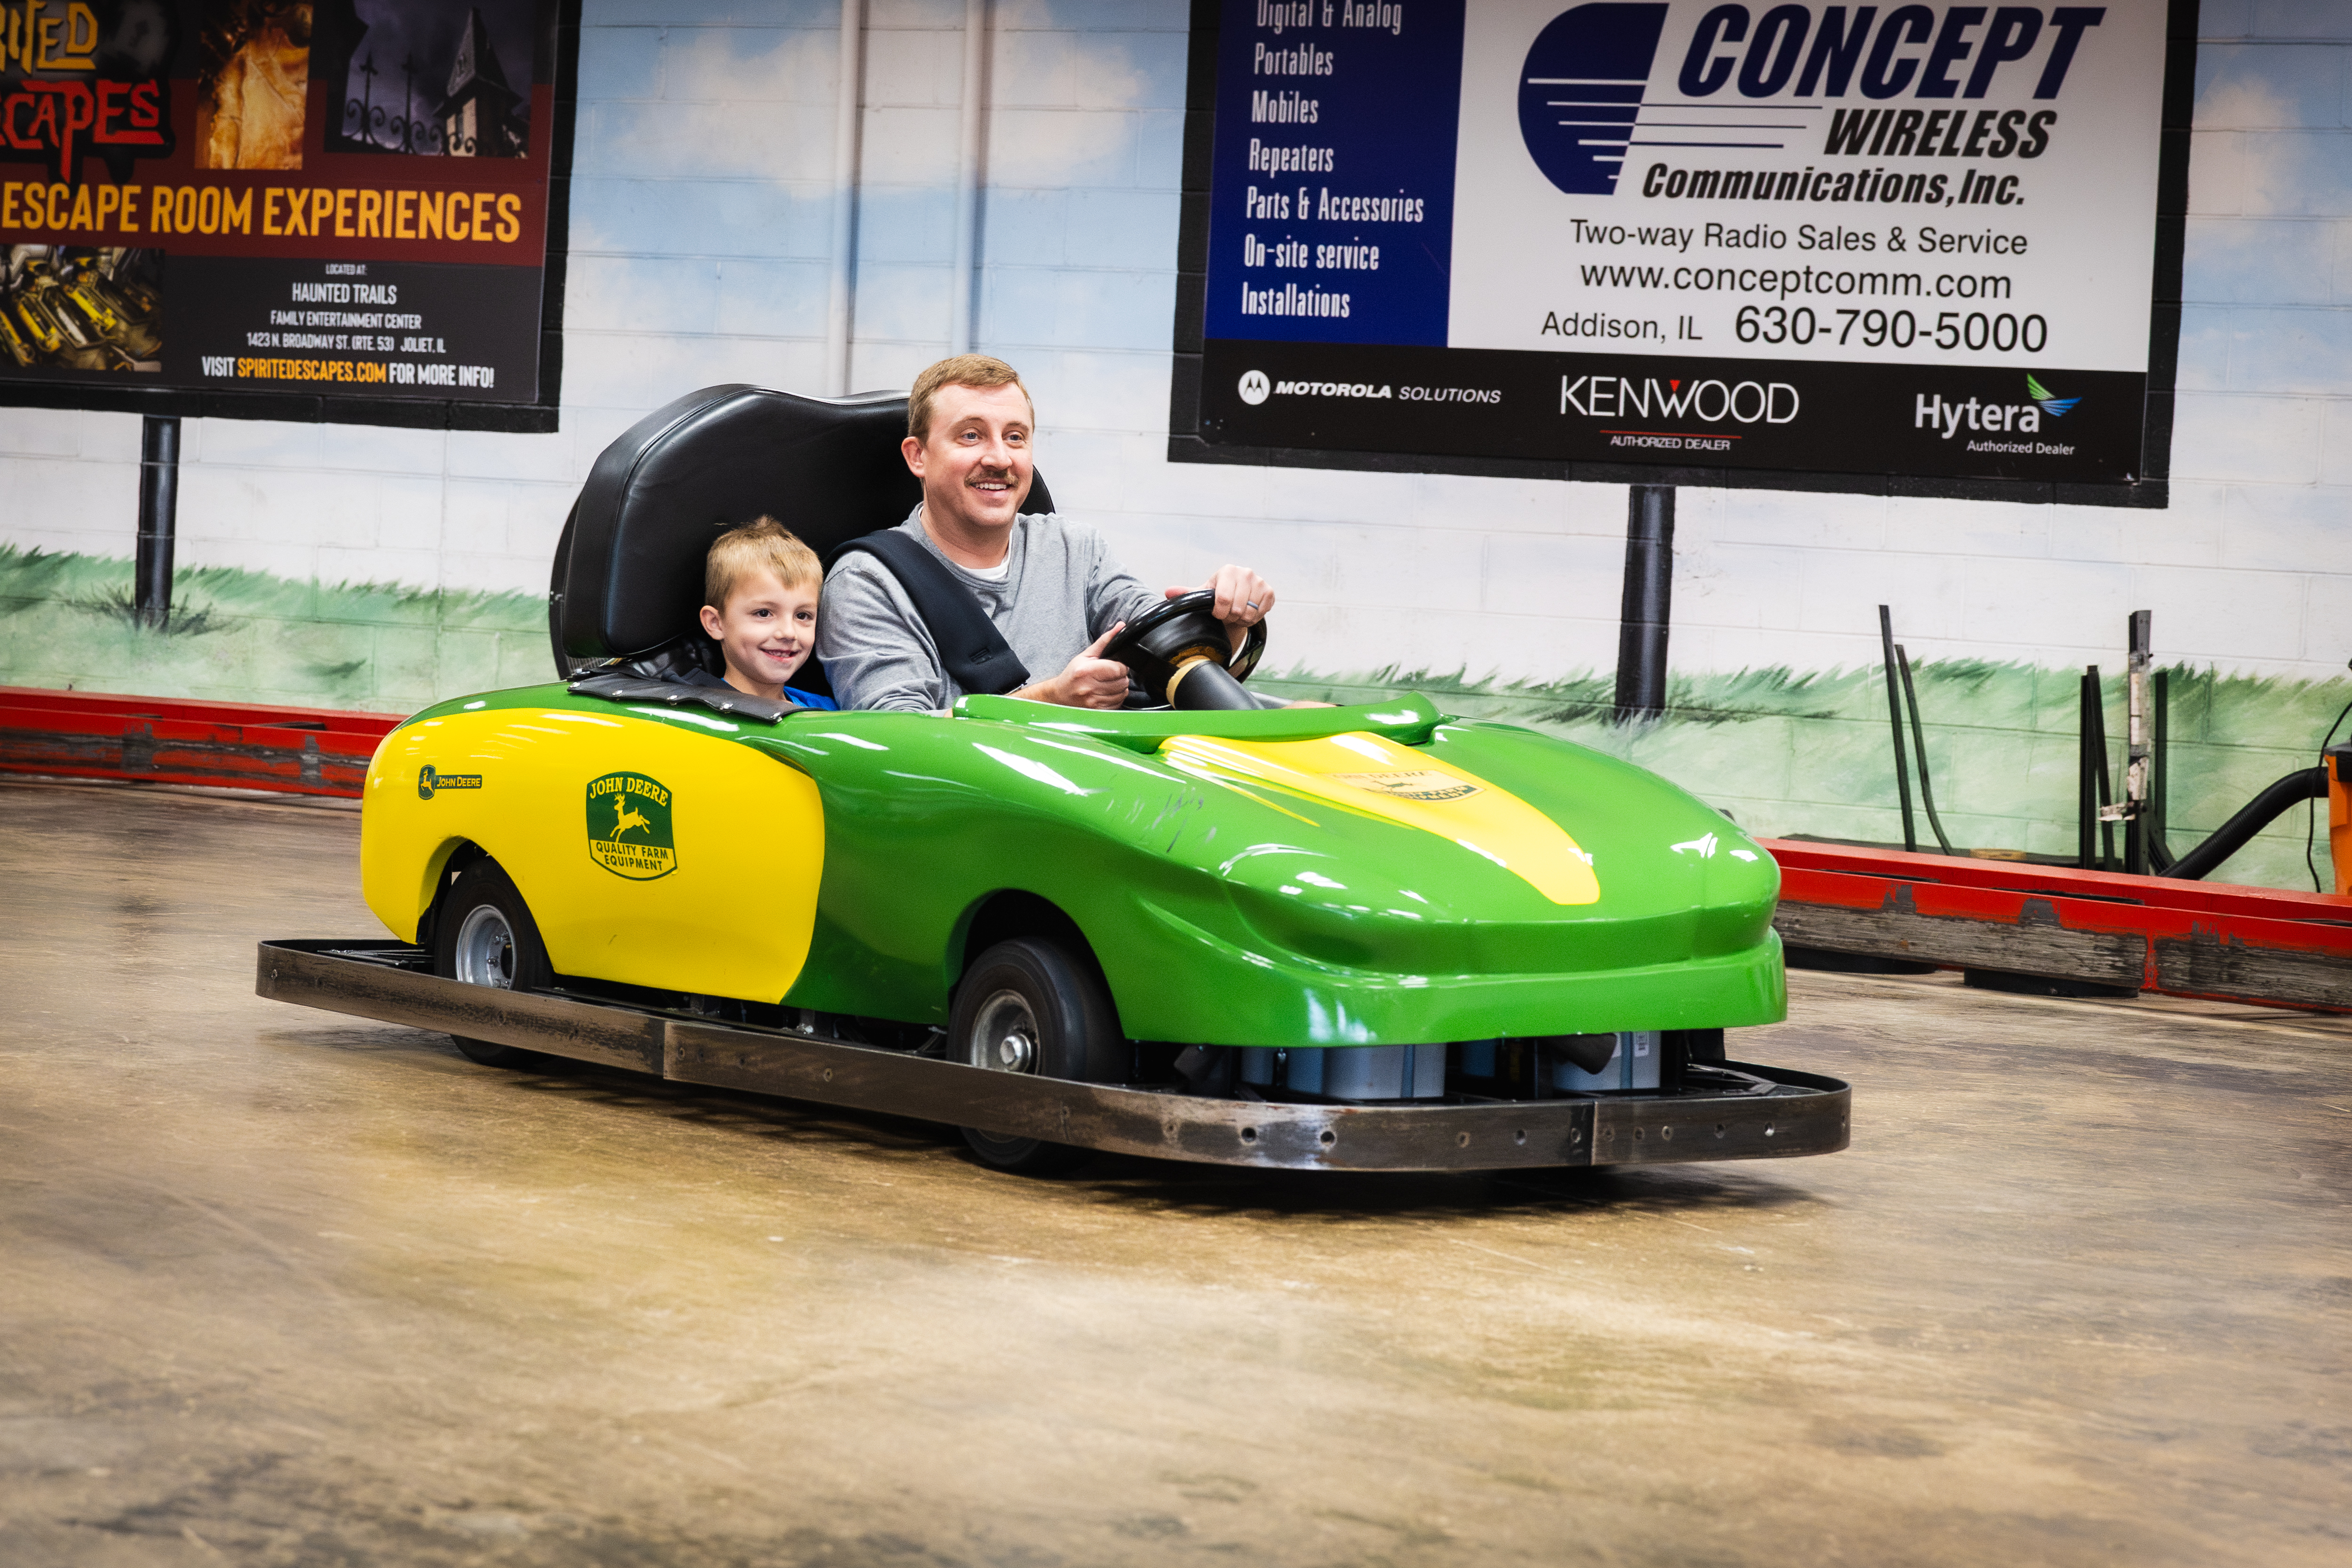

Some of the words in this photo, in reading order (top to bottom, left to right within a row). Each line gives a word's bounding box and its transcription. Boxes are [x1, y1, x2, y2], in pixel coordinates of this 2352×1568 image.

[1257, 0, 1314, 34] Digital
[1322, 0, 1334, 27] &
[1343, 0, 1402, 35] Analog
[0, 0, 98, 74] ITED
[1678, 3, 2107, 100] CONCEPT
[1254, 42, 1334, 76] Portables
[1251, 90, 1319, 123] Mobiles
[0, 79, 164, 183] CAPES
[1823, 108, 2058, 159] WIRELESS
[1248, 138, 1334, 178] Repeaters
[2, 182, 141, 232] ESCAPE
[151, 185, 253, 234] ROOM
[263, 188, 521, 243] EXPERIENCES
[1246, 186, 1289, 219] Parts
[1297, 187, 1310, 220] &
[1318, 187, 1424, 223] Accessories
[1244, 233, 1308, 268] On-site
[1316, 236, 1379, 270] service
[1570, 219, 1693, 253] Two-way
[1705, 223, 1787, 249] Radio
[1798, 224, 1876, 251] Sales
[1887, 226, 1907, 252] &
[1917, 227, 2028, 255] Service
[326, 263, 355, 275] LOCATED
[1581, 264, 2011, 301] www.conceptcomm.com
[292, 282, 350, 303] HAUNTED
[353, 284, 397, 304] TRAILS
[1241, 281, 1350, 318] Installations
[270, 310, 305, 326] FAMILY
[306, 311, 383, 328] ENTERTAINMENT
[384, 313, 421, 329] CENTER
[1541, 311, 1666, 344] Addison,
[1678, 315, 1703, 340] IL
[1735, 305, 2048, 352] 630-790-5000
[246, 332, 270, 347] 1423
[271, 332, 281, 347] N.
[282, 333, 334, 349] BROADWAY
[335, 334, 350, 350] ST.
[352, 335, 375, 350] (RTE.
[377, 336, 394, 351] 53)
[437, 338, 446, 353] IL
[202, 356, 235, 377] VISIT
[237, 358, 386, 383] SPIRITEDESCAPES.COM
[389, 362, 415, 384] FOR
[417, 364, 456, 386] MORE
[458, 365, 494, 388] INFO!
[1274, 381, 1392, 398] MOTOROLA
[1398, 386, 1501, 404] SOLUTIONS
[1560, 375, 1799, 423] KENWOOD
[1915, 393, 2041, 439] Hytera
[1610, 436, 1682, 449] AUTHORIZED
[1685, 438, 1731, 450] DEALER
[1967, 439, 2033, 454] Authorized
[2036, 442, 2075, 455] Dealer
[437, 777, 456, 787] JOHN
[457, 776, 481, 787] DEERE
[590, 777, 623, 799] JOHN
[626, 777, 668, 807] DEERE
[596, 842, 636, 856] QUALITY
[642, 847, 668, 859] FARM
[604, 854, 662, 871] EQUIPMENT
